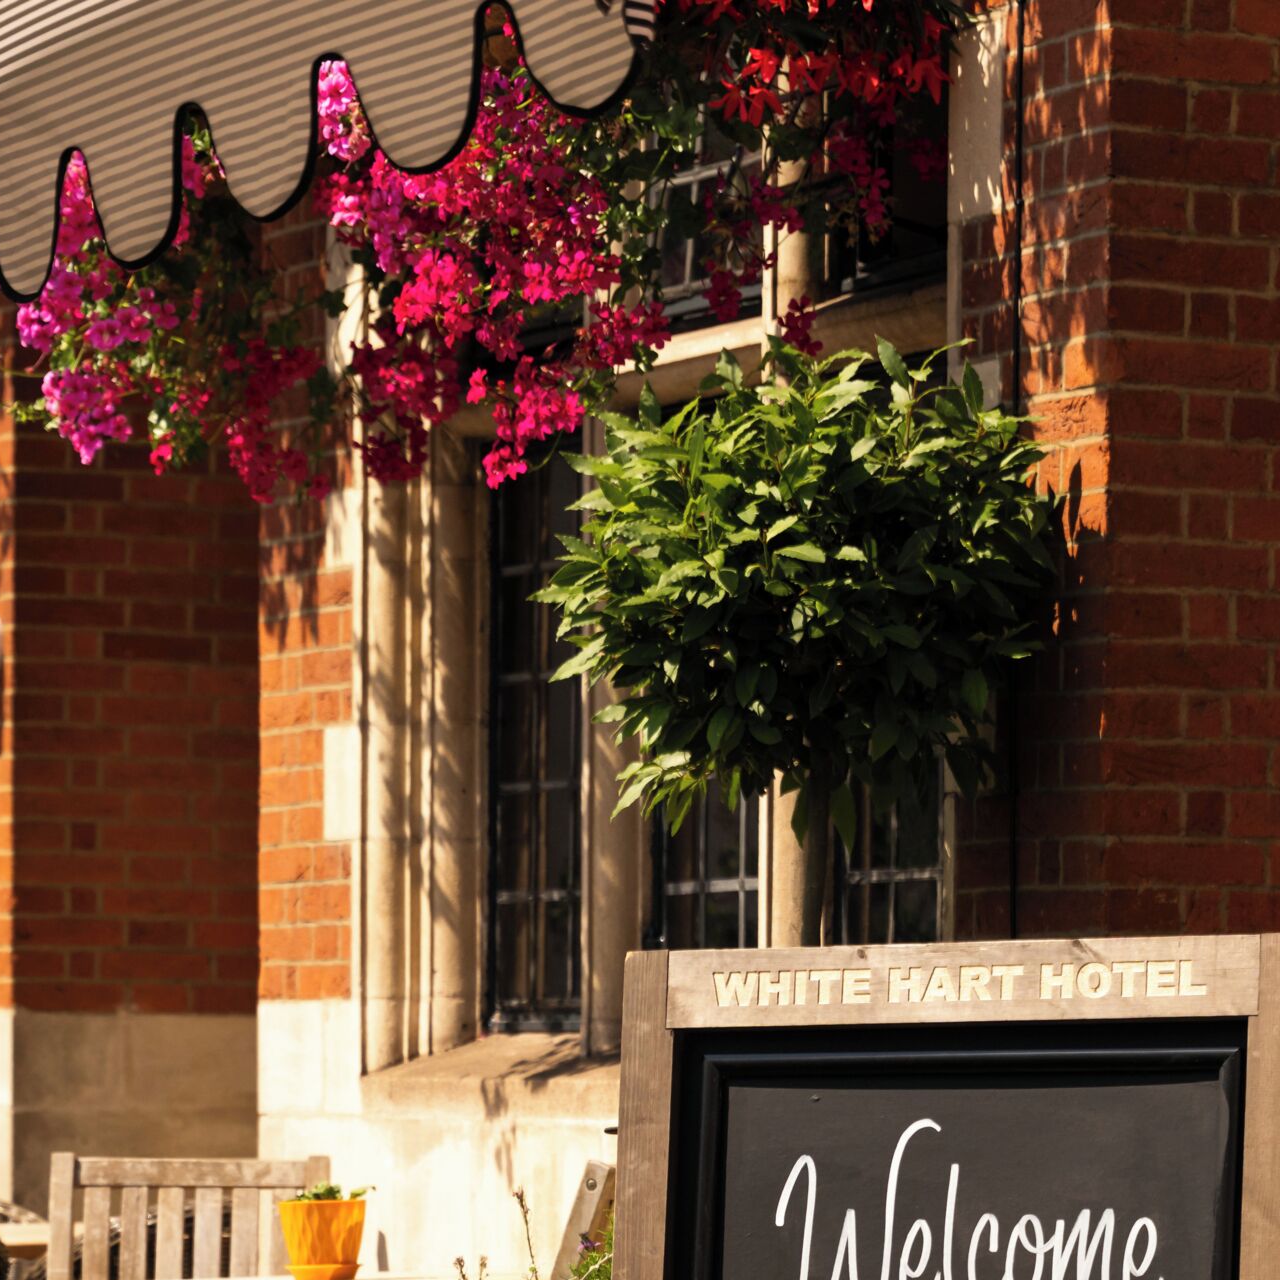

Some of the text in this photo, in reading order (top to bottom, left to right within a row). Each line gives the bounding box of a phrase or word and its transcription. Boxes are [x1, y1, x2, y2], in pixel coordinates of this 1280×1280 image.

[713, 959, 1207, 1007] WHITE HART HOTEL
